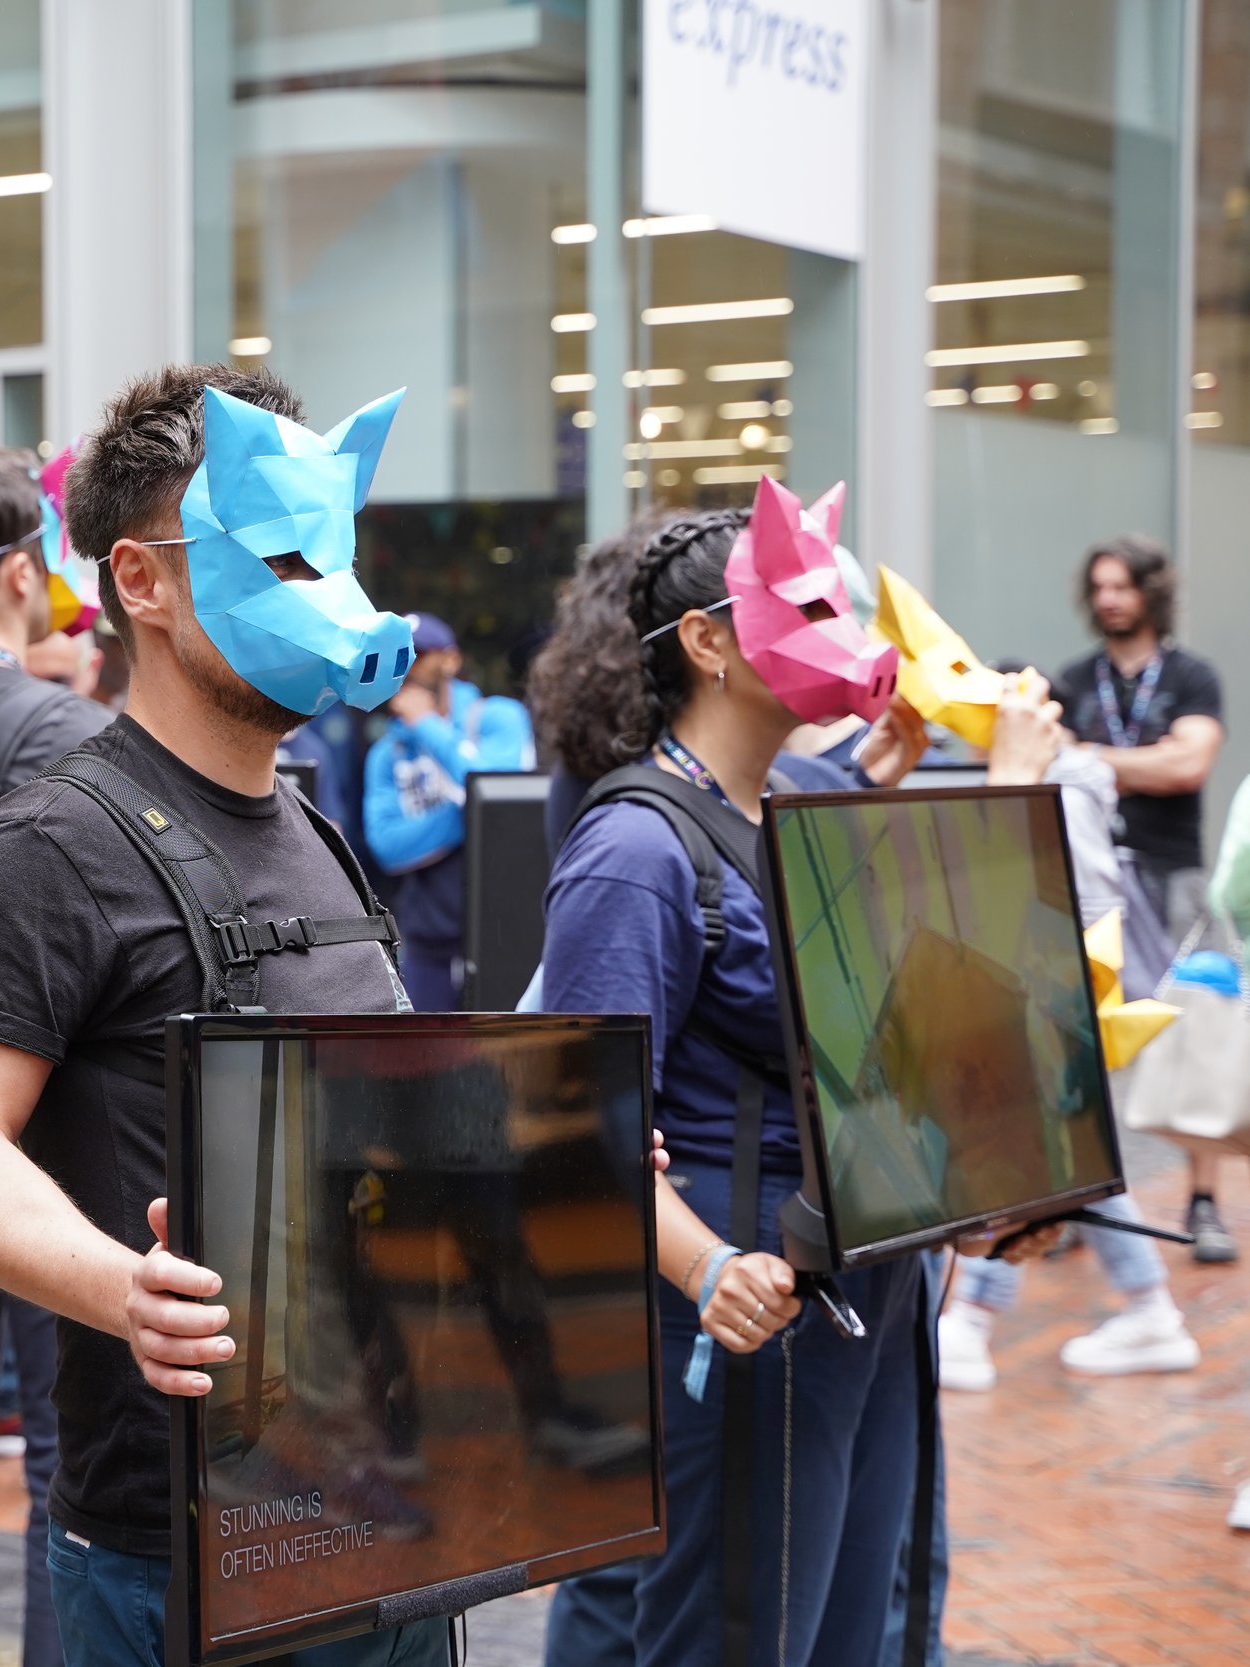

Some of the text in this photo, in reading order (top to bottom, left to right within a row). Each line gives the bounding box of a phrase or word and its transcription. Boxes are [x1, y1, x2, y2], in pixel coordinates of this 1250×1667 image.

[668, 0, 848, 93] express
[220, 1491, 322, 1537] STUNNING IS
[221, 1521, 374, 1579] OFTEN INEFFECTIVE
